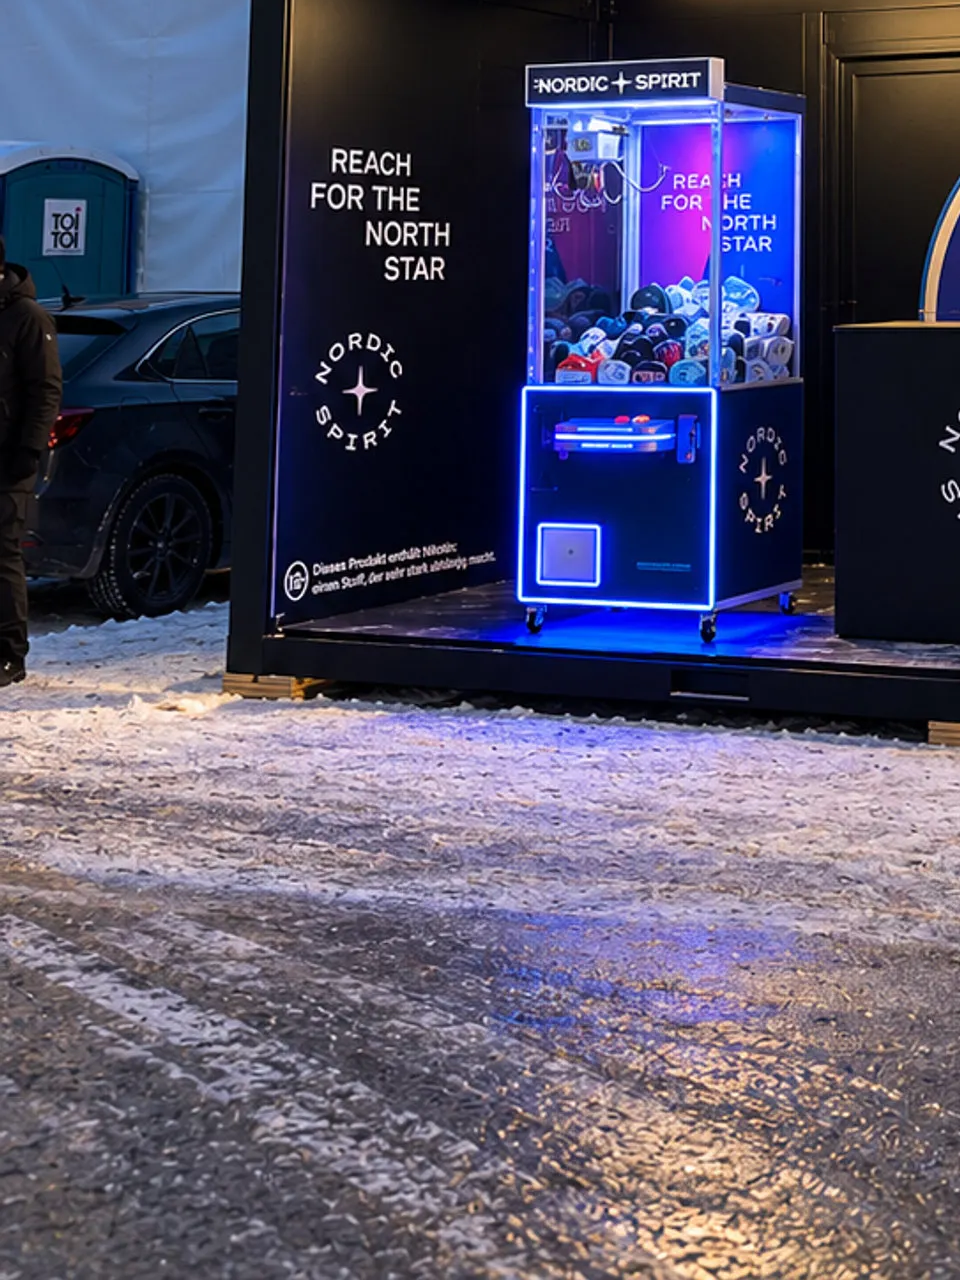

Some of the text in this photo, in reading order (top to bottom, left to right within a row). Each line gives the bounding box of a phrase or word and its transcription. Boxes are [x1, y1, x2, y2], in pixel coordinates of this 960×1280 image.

[635, 72, 701, 90] SPIRIT
[331, 148, 412, 177] REACH
[673, 173, 741, 189] REAH
[310, 182, 421, 212] FOR THE
[661, 193, 752, 211] FOR HE
[51, 231, 79, 249] TOI
[365, 220, 450, 247] NORTH
[384, 255, 445, 281] STAR
[314, 332, 403, 385] NORDIC
[315, 399, 403, 451] SPIRIT
